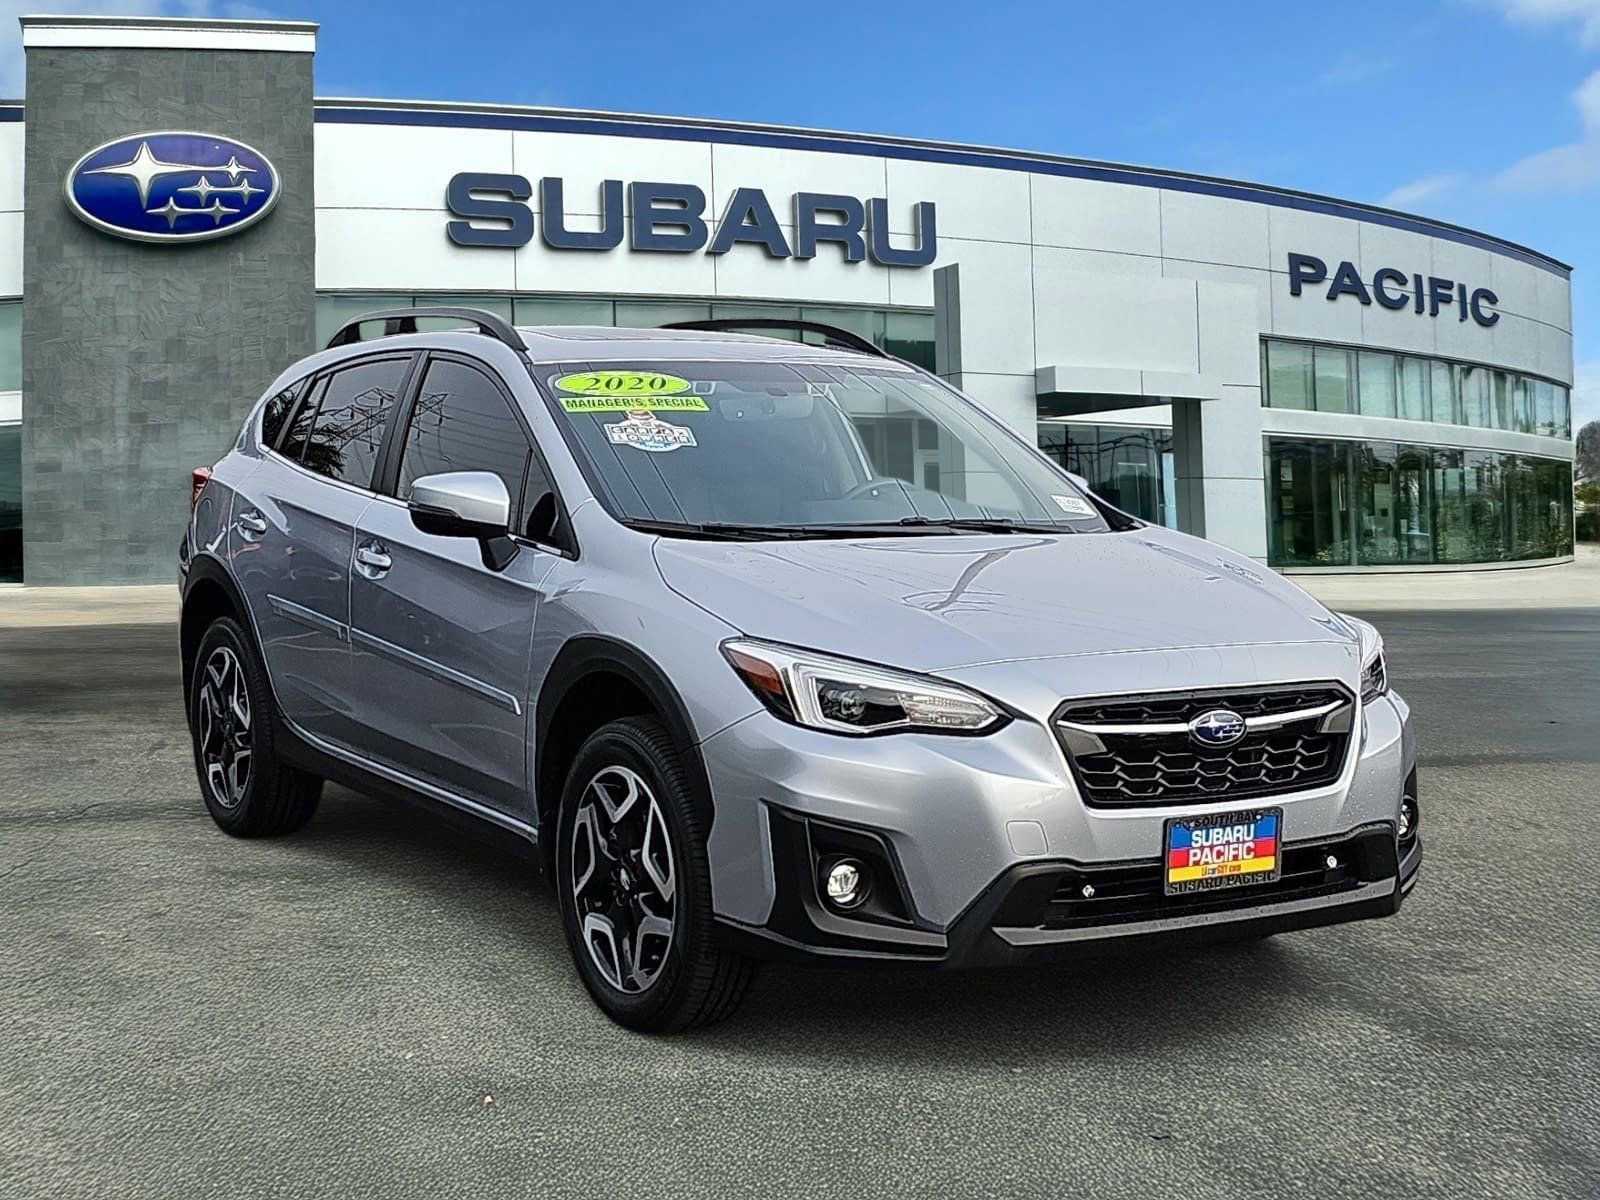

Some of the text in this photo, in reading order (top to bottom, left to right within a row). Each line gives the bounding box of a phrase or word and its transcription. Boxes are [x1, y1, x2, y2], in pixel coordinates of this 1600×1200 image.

[447, 171, 937, 267] SUBARU
[1288, 252, 1500, 327] PACIFIC
[585, 377, 667, 391] 2020
[565, 397, 704, 410] MANAGER'S SPECIAL
[1194, 811, 1256, 827] SOUTH BAY
[1191, 824, 1255, 847] SUBARU
[1188, 841, 1255, 867] PACIFIC
